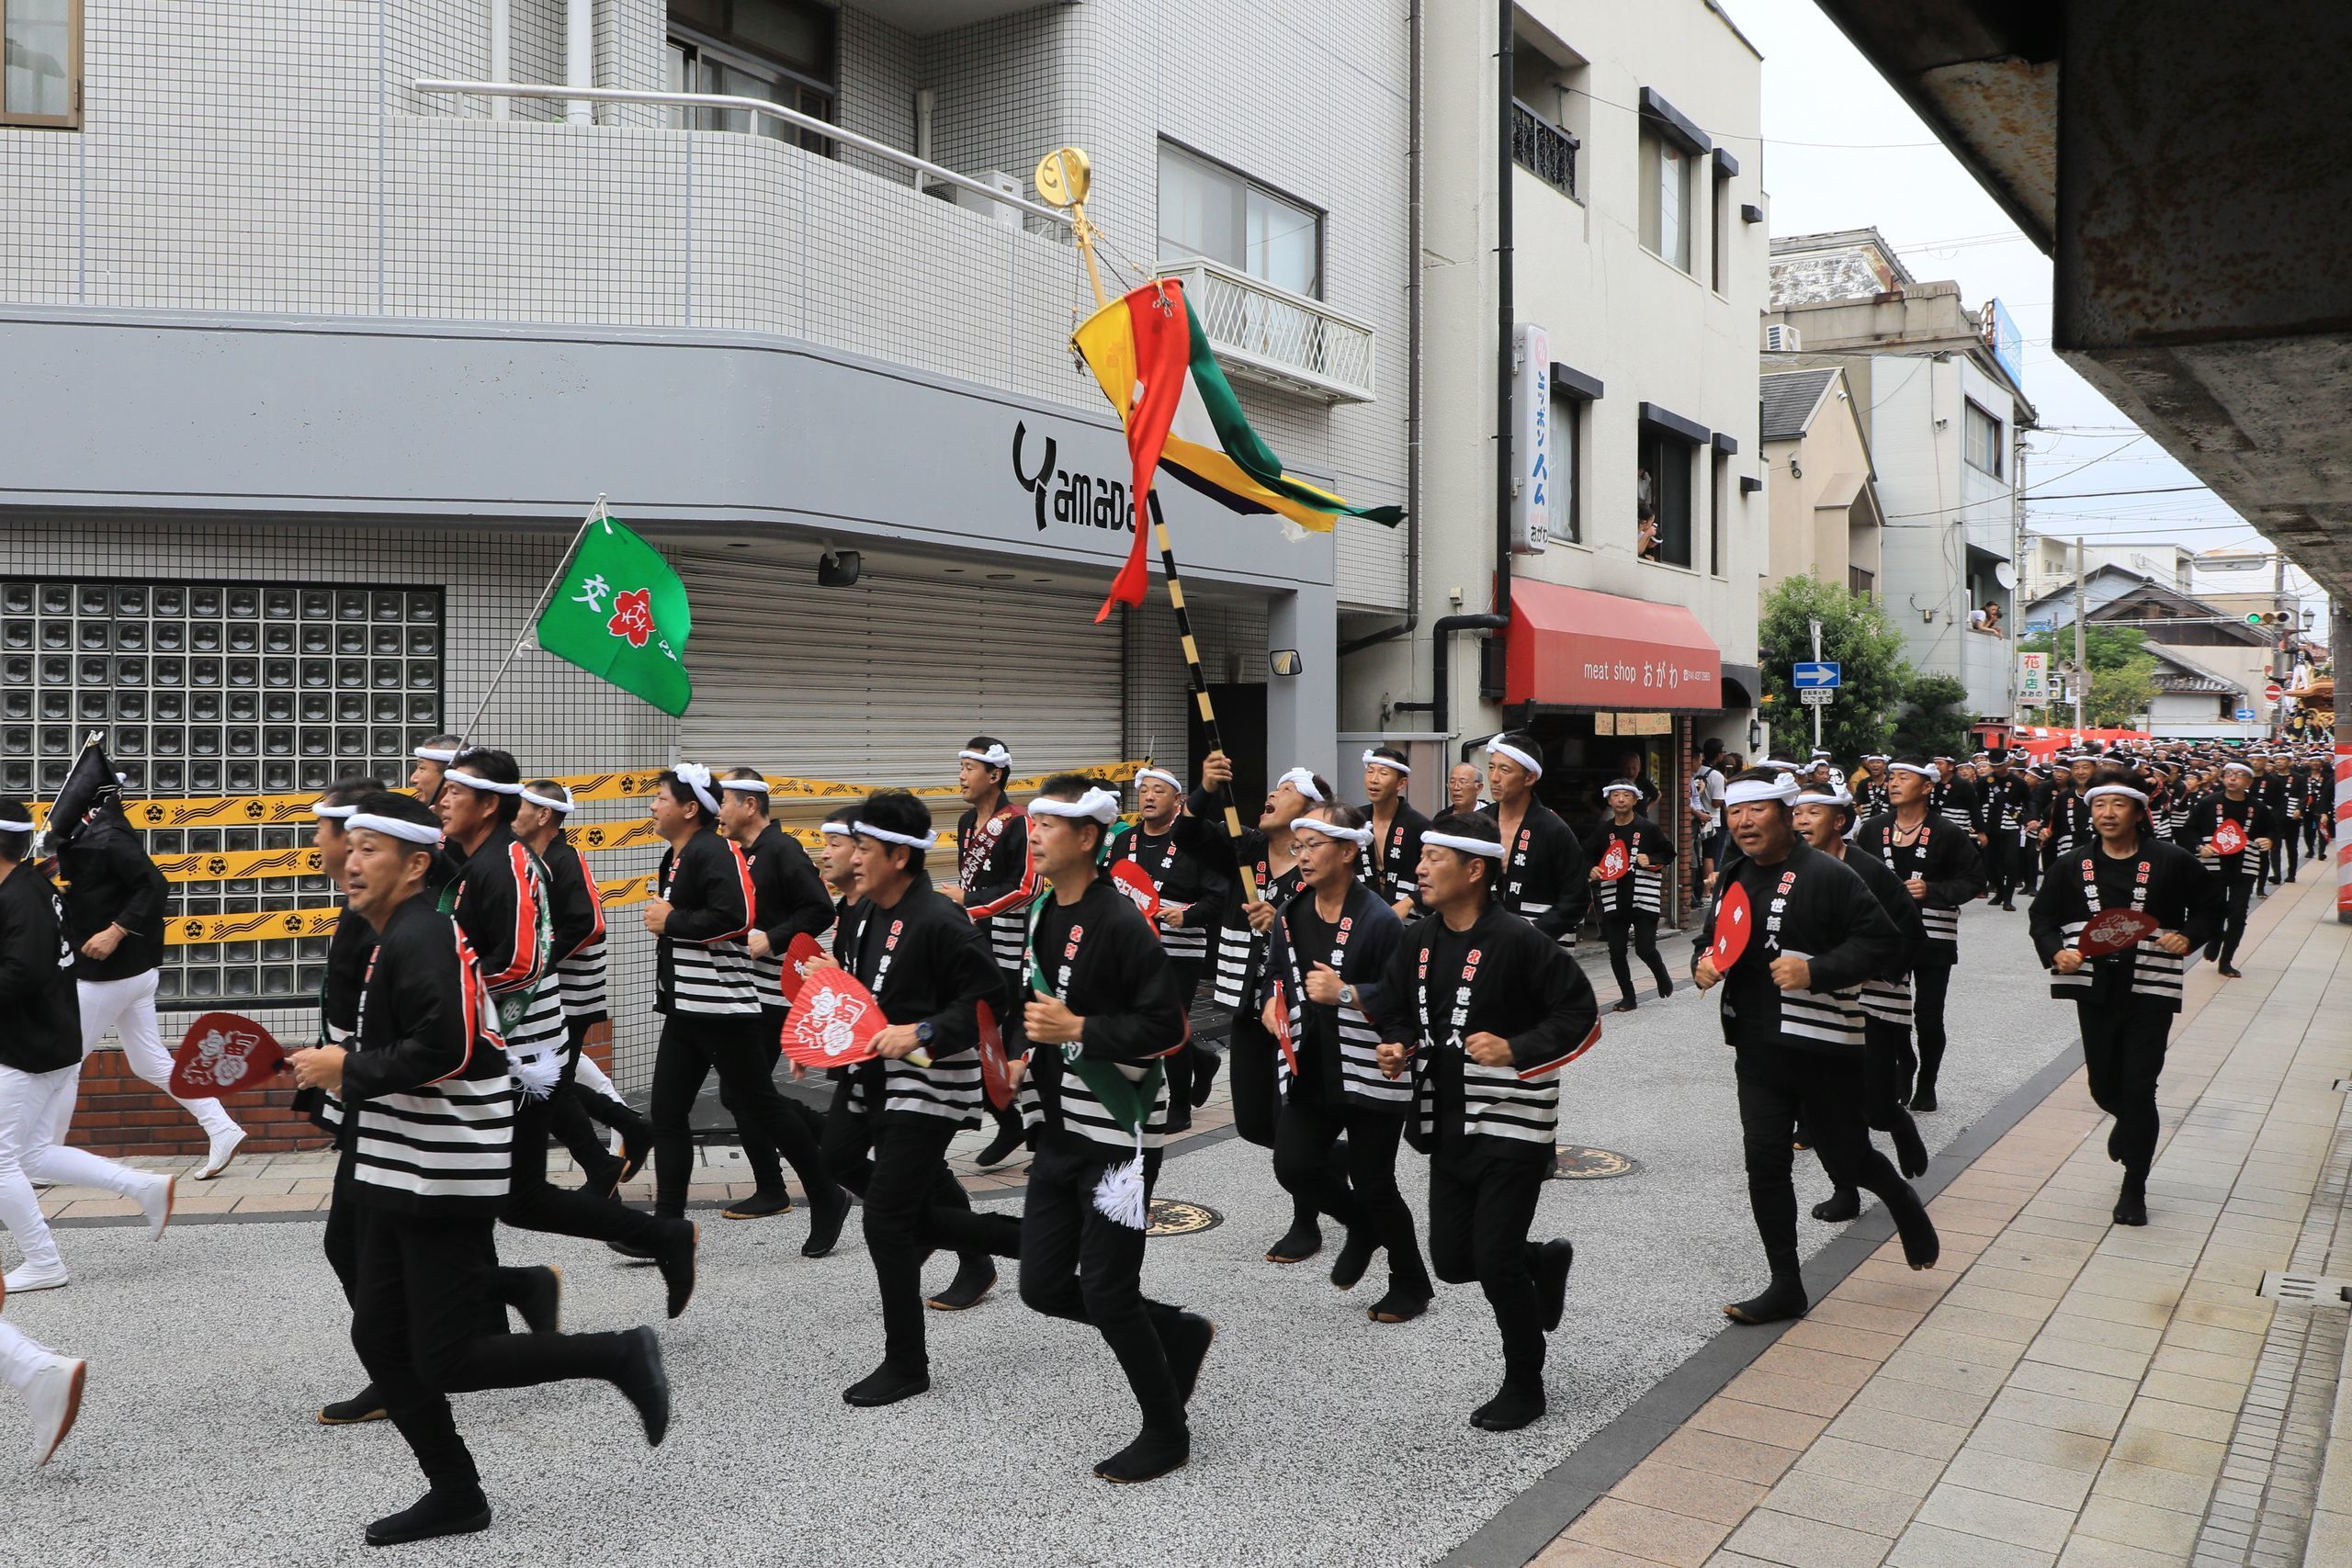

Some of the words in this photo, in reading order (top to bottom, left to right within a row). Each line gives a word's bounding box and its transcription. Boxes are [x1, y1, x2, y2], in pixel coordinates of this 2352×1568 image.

[1531, 525, 1548, 543] おがわ
[1584, 662, 1609, 680] meat
[1614, 660, 1636, 683] shop
[1643, 660, 1679, 689] おがわ
[2024, 654, 2041, 689] 花の店
